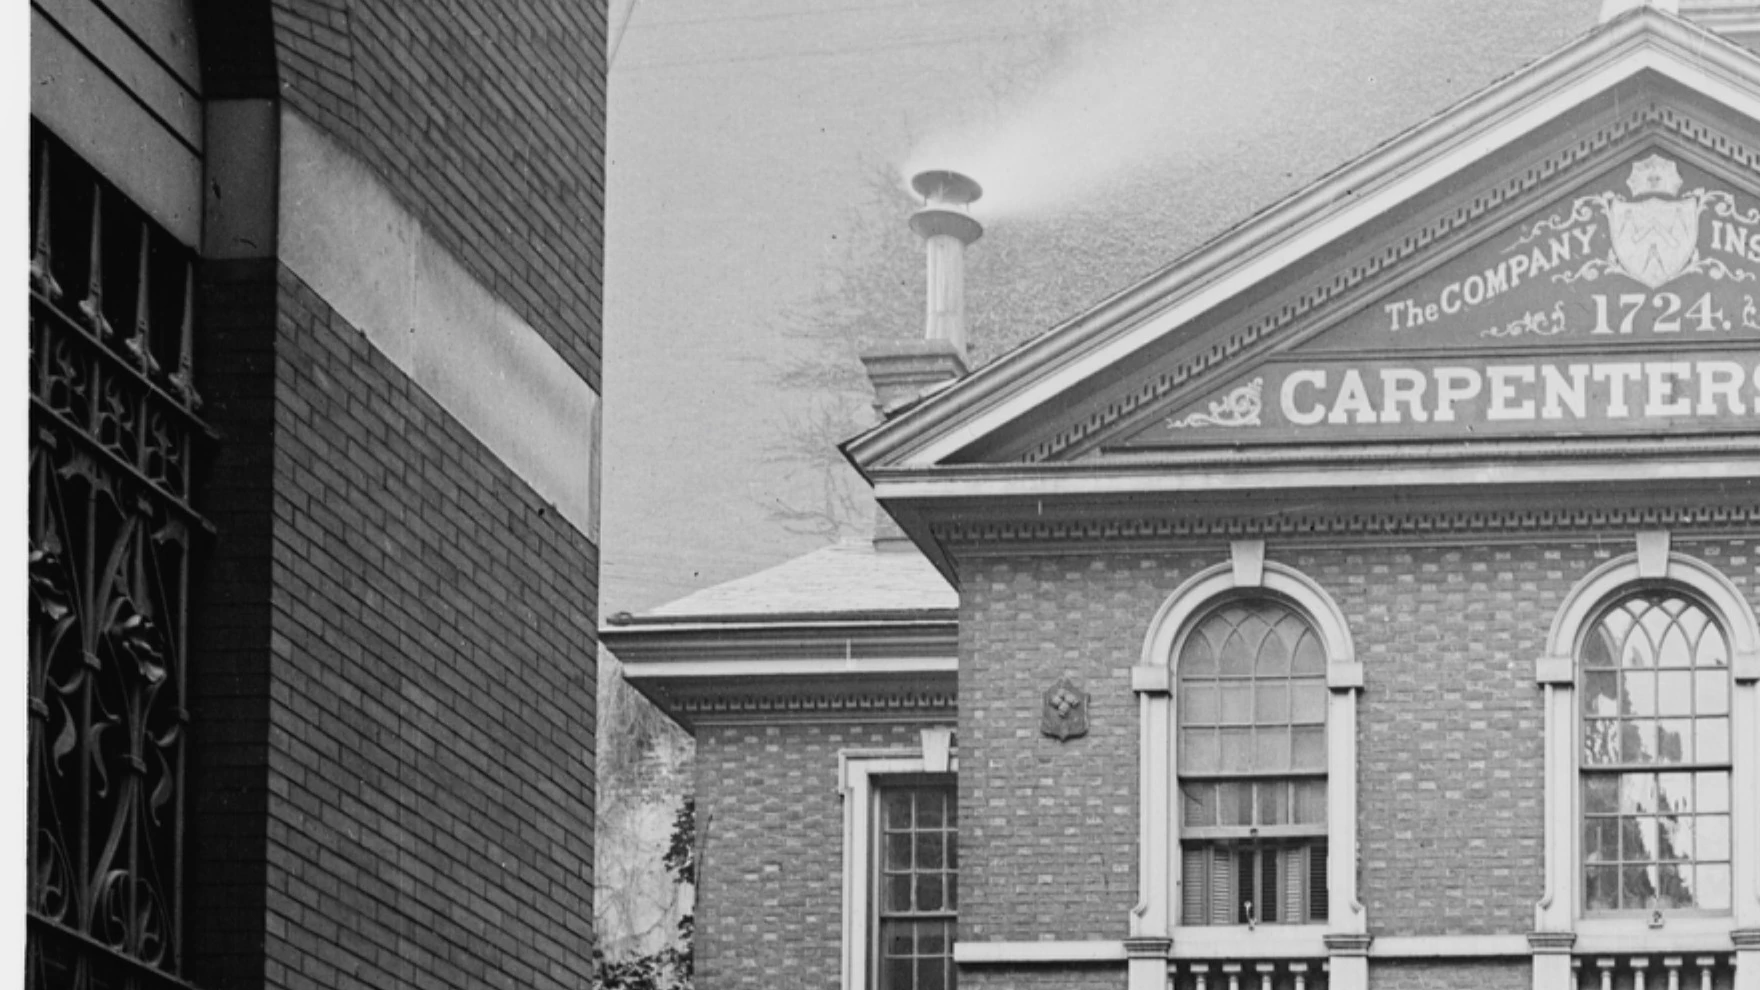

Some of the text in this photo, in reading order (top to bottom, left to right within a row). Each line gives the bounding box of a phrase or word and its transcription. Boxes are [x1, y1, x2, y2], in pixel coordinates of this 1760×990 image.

[1384, 299, 1439, 331] The
[1440, 224, 1597, 314] COMPANY
[1590, 291, 1732, 335] 1724.
